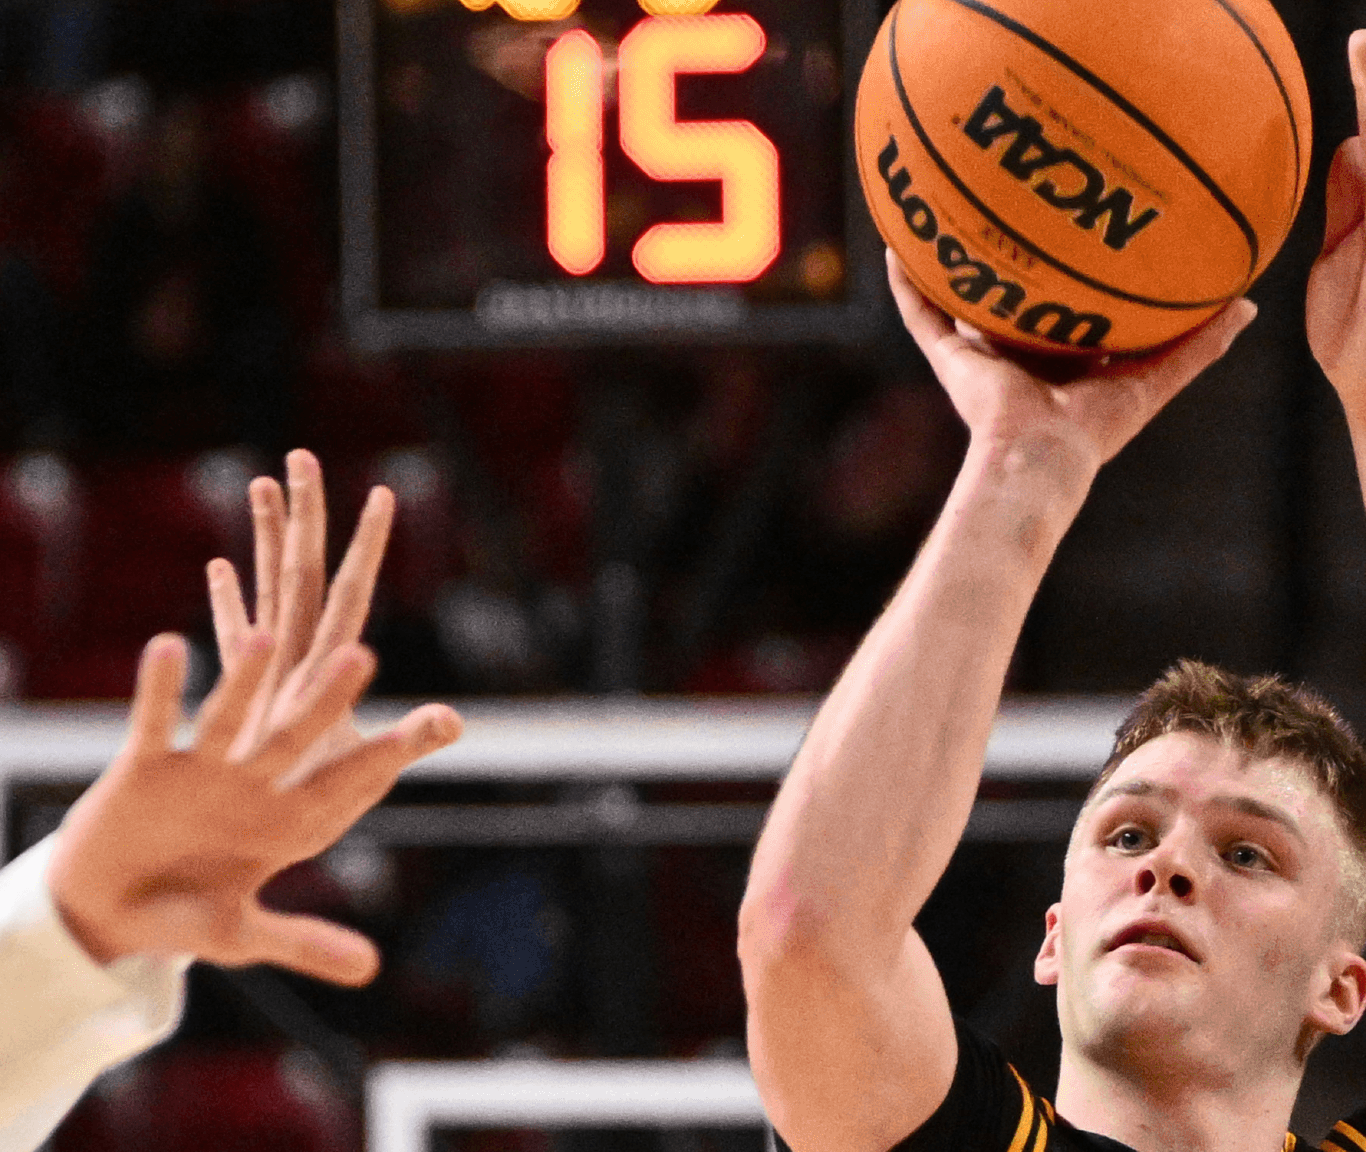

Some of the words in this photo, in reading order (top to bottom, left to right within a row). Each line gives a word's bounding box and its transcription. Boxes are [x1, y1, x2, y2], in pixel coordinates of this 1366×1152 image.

[545, 13, 781, 285] 15
[877, 135, 1112, 348] Wilson
[963, 86, 1160, 250] NCAA
